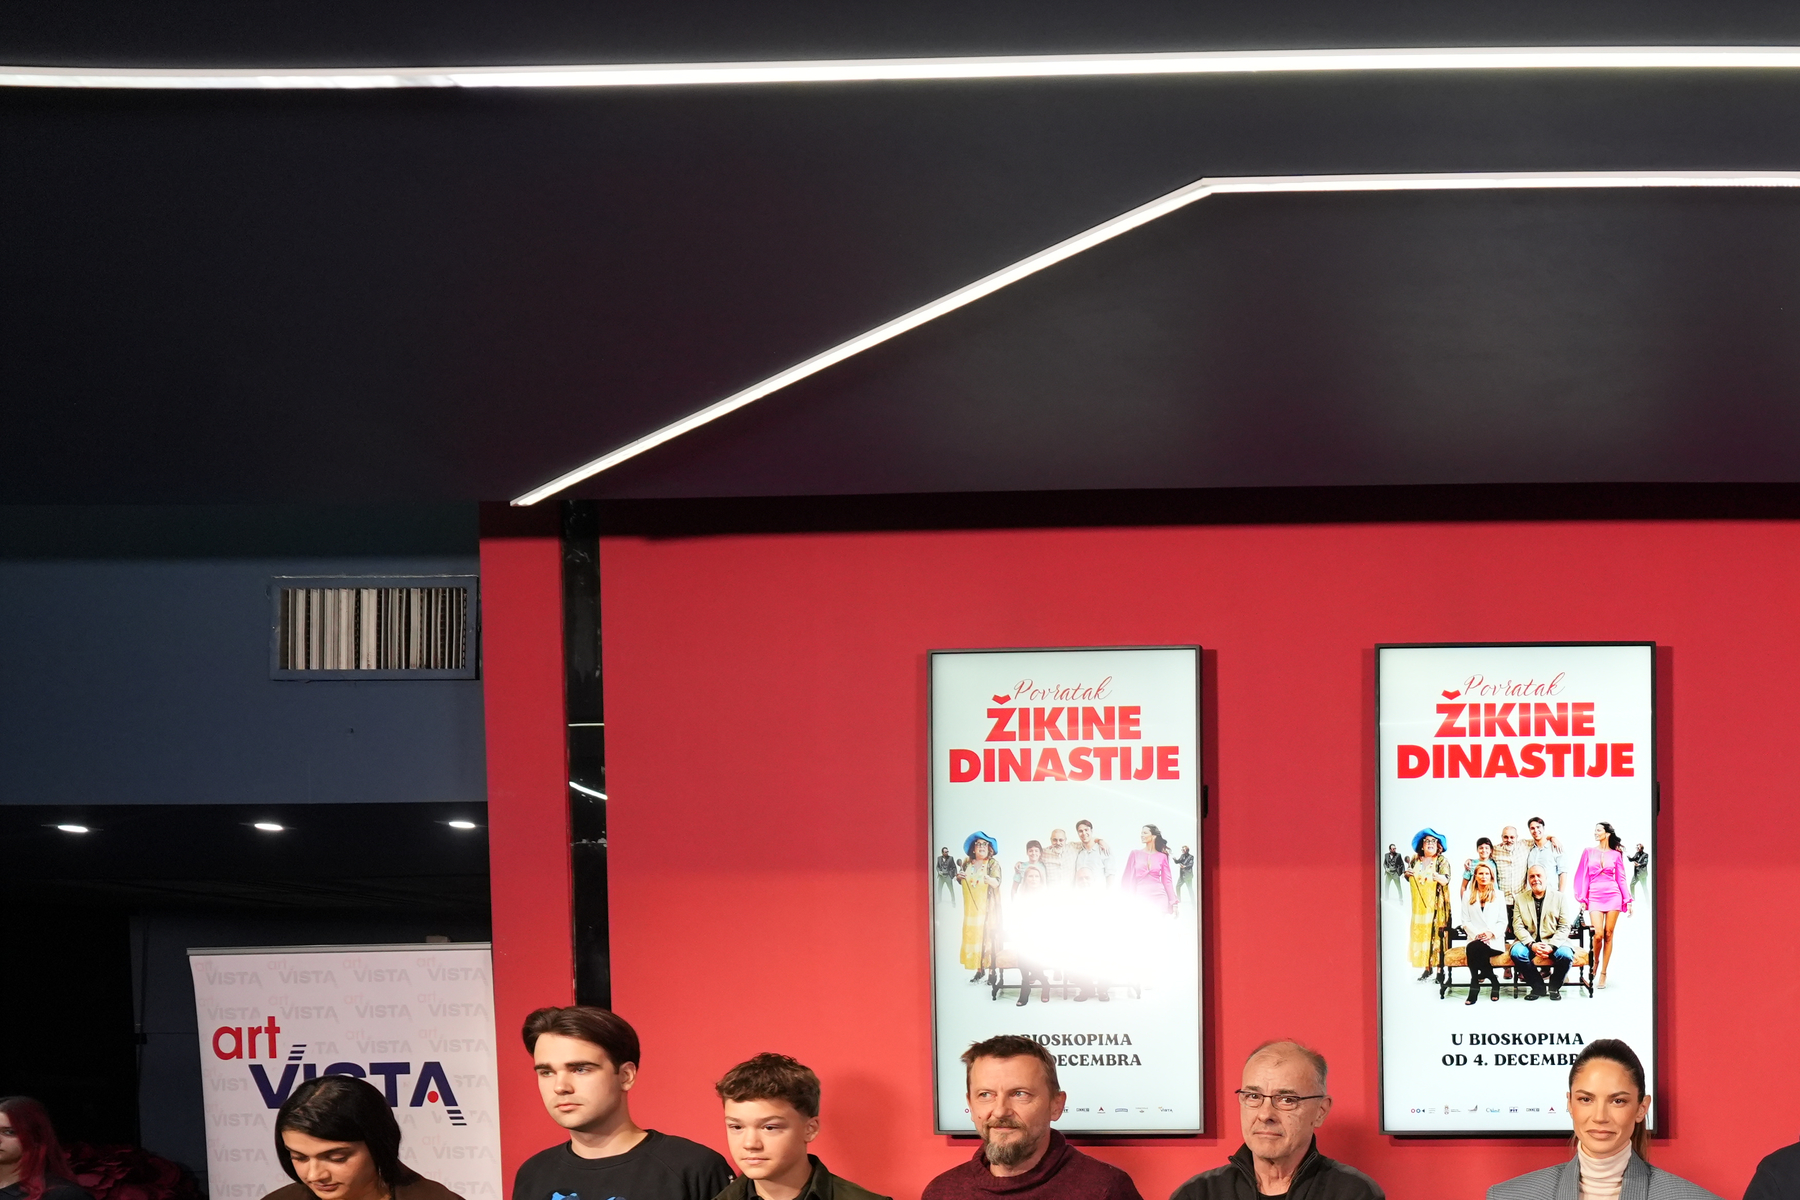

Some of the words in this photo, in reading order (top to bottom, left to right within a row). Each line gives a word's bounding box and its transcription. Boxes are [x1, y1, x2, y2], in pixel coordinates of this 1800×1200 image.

[1014, 676, 1113, 701] Povratak
[1464, 672, 1566, 696] Povratak
[985, 694, 1141, 742] ŽIKINE
[1434, 690, 1595, 737] ŽIKINE
[949, 746, 1180, 782] DINASTIJE
[1397, 743, 1634, 778] DINASTIJE
[206, 971, 262, 985] VISTA
[279, 971, 336, 984] VISTA
[354, 969, 410, 982] VISTA
[428, 968, 487, 981] VISTA
[281, 1006, 338, 1020] VISTA
[355, 1005, 411, 1018] VISTA
[429, 1004, 488, 1017] VISTA
[212, 1015, 281, 1061] art
[1451, 1033, 1463, 1045] U
[1469, 1033, 1584, 1045] BIOSKOPIMA
[357, 1040, 412, 1054] VISTA
[429, 1039, 489, 1053] VISTA
[1441, 1054, 1468, 1066] OD
[1473, 1054, 1488, 1066] 4.
[1494, 1053, 1579, 1066] DECEMB
[210, 1078, 248, 1091] VIST
[248, 1061, 459, 1109] VTA
[454, 1075, 490, 1088] STA
[212, 1113, 266, 1126] VISTA
[214, 1149, 267, 1162] VISTA
[433, 1146, 493, 1159] VISTA
[447, 1181, 495, 1194] STA
